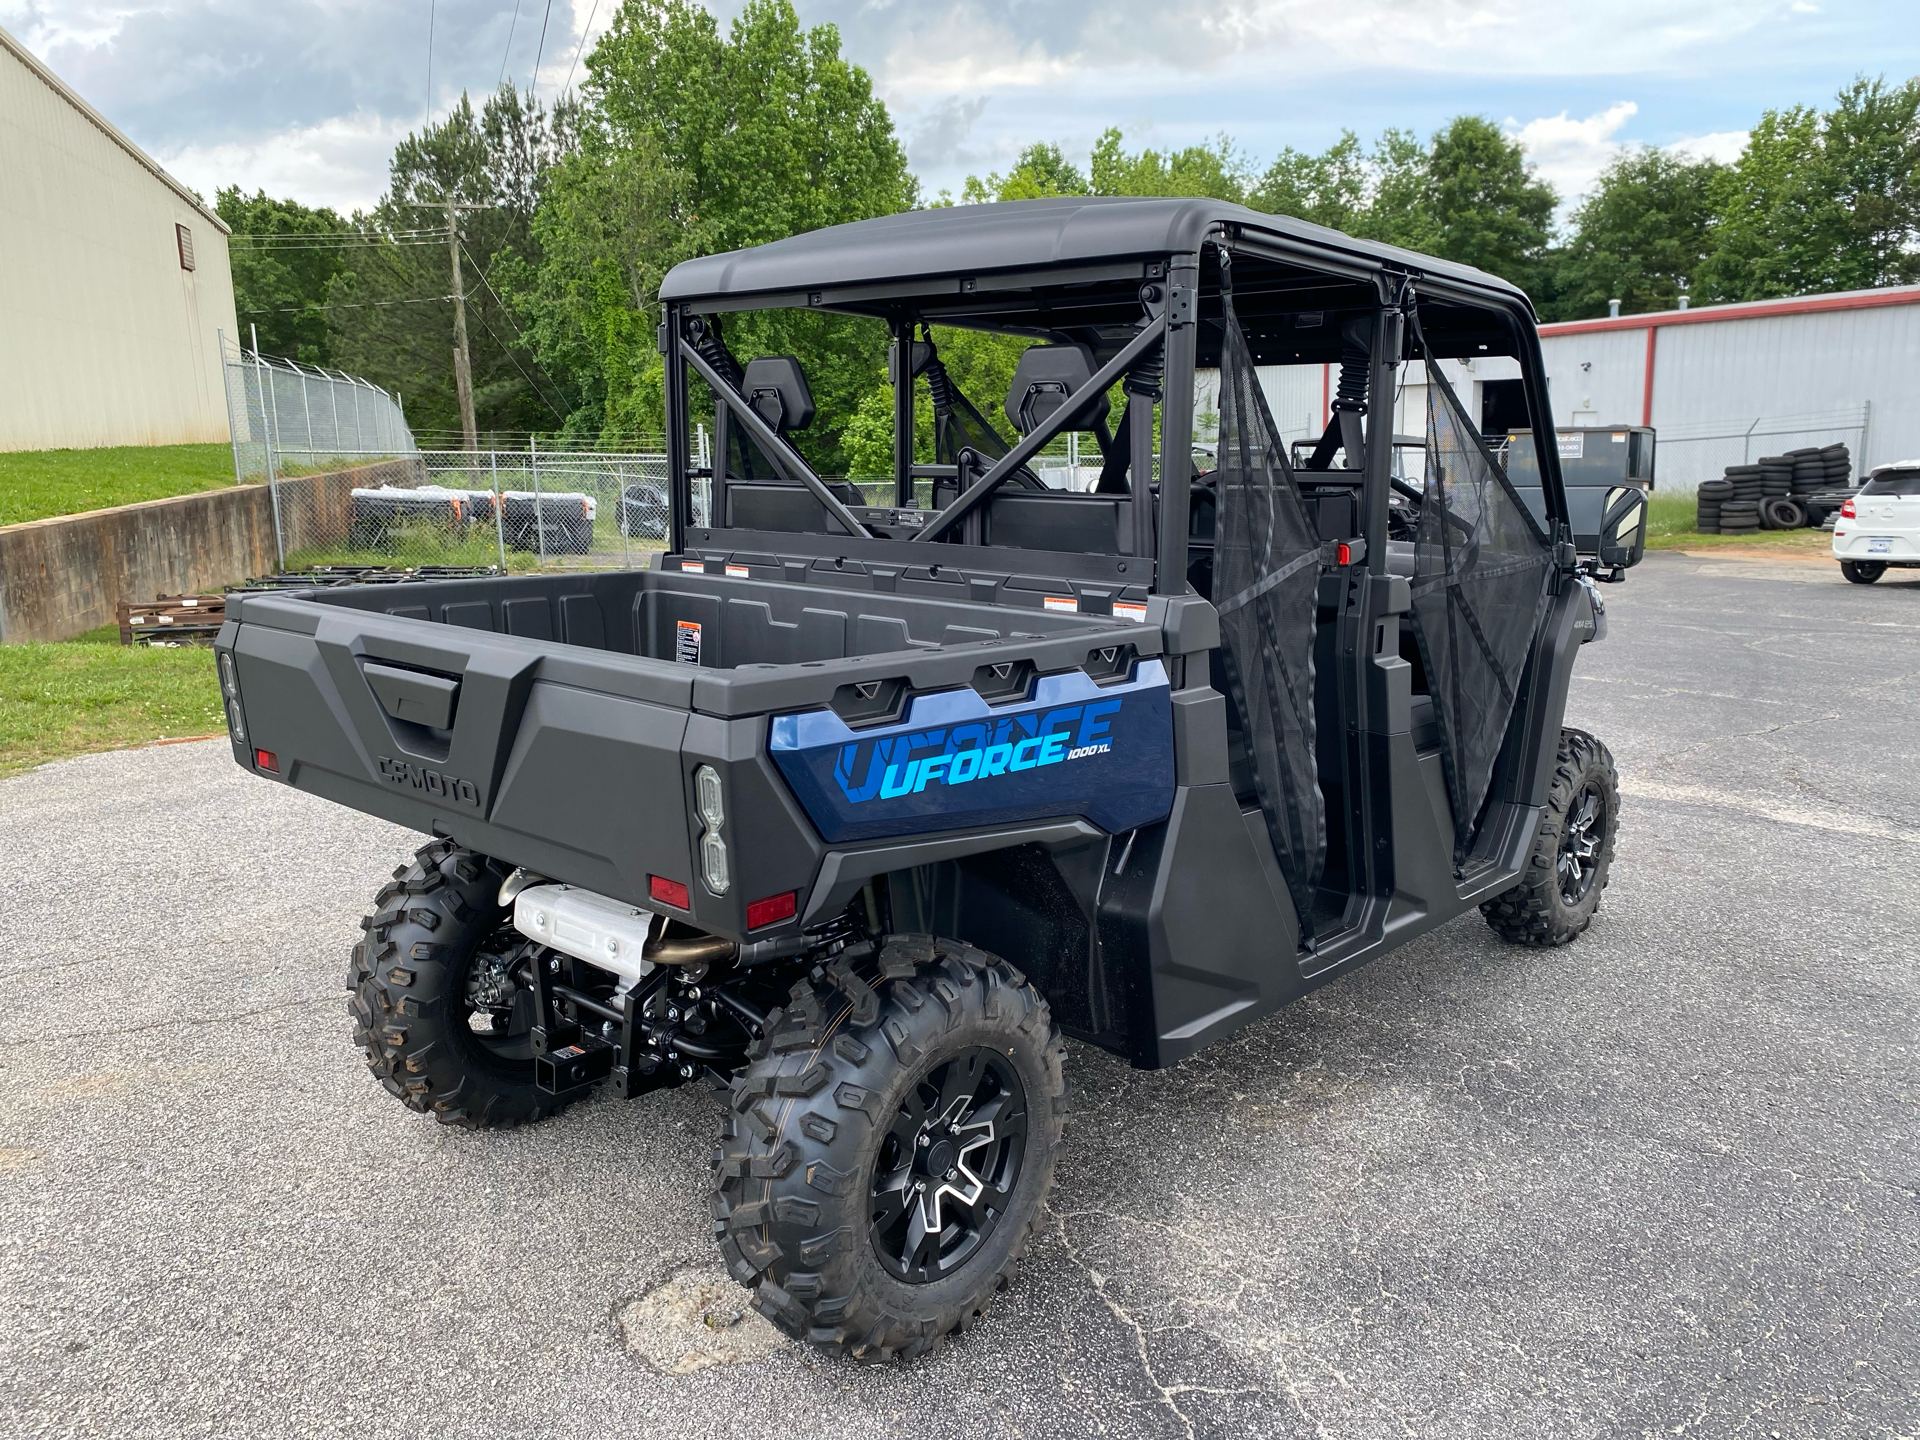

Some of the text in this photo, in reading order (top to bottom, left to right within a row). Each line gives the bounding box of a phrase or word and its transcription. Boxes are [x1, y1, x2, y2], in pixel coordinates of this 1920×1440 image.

[880, 731, 1070, 800] UFORCE
[1067, 743, 1111, 760] 1000 XL
[378, 756, 480, 807] CFMOTO
